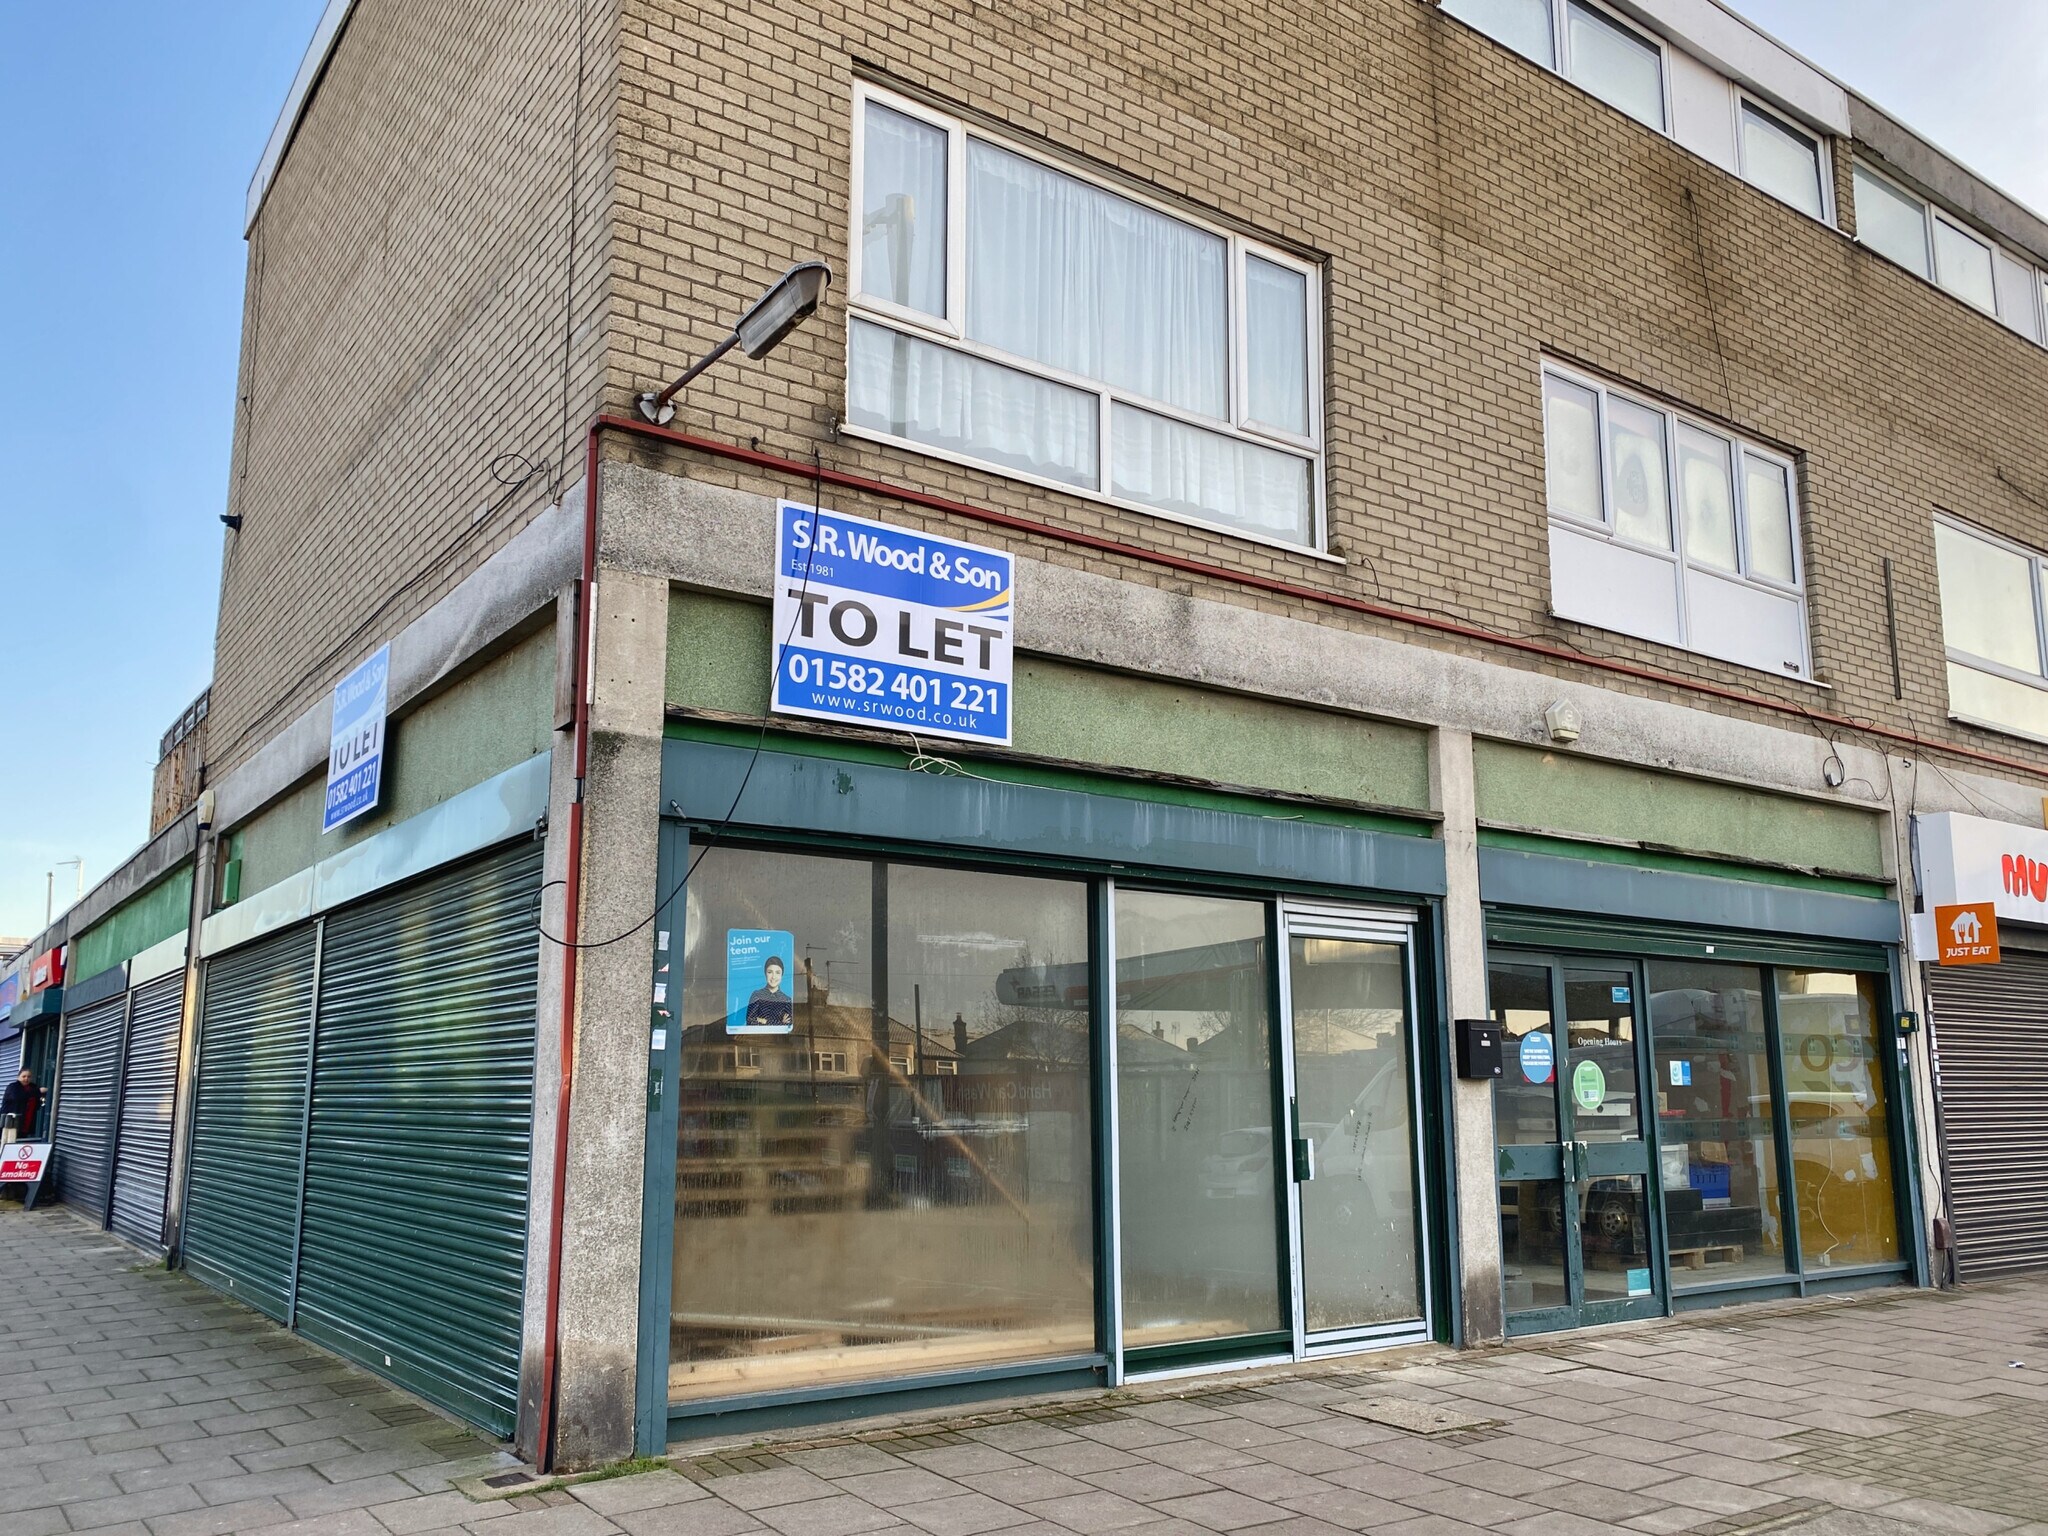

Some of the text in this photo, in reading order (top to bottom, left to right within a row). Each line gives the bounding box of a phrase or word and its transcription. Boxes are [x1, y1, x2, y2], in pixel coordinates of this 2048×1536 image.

[847, 531, 925, 575] Wood
[929, 551, 951, 582] &
[954, 556, 1001, 591] Son
[809, 563, 834, 578] 1981
[788, 588, 1003, 671] TO LET
[788, 653, 998, 715] 01582 401 221
[811, 691, 977, 729] www.srwood.co.uk
[327, 760, 377, 810] 01582 401 221
[730, 935, 771, 946] Join our
[730, 946, 760, 955] team.
[1946, 945, 1992, 958] JUST EAT
[1577, 1036, 1623, 1047] Opening Hours
[15, 1161, 28, 1169] No
[1, 1170, 36, 1178] smoking
